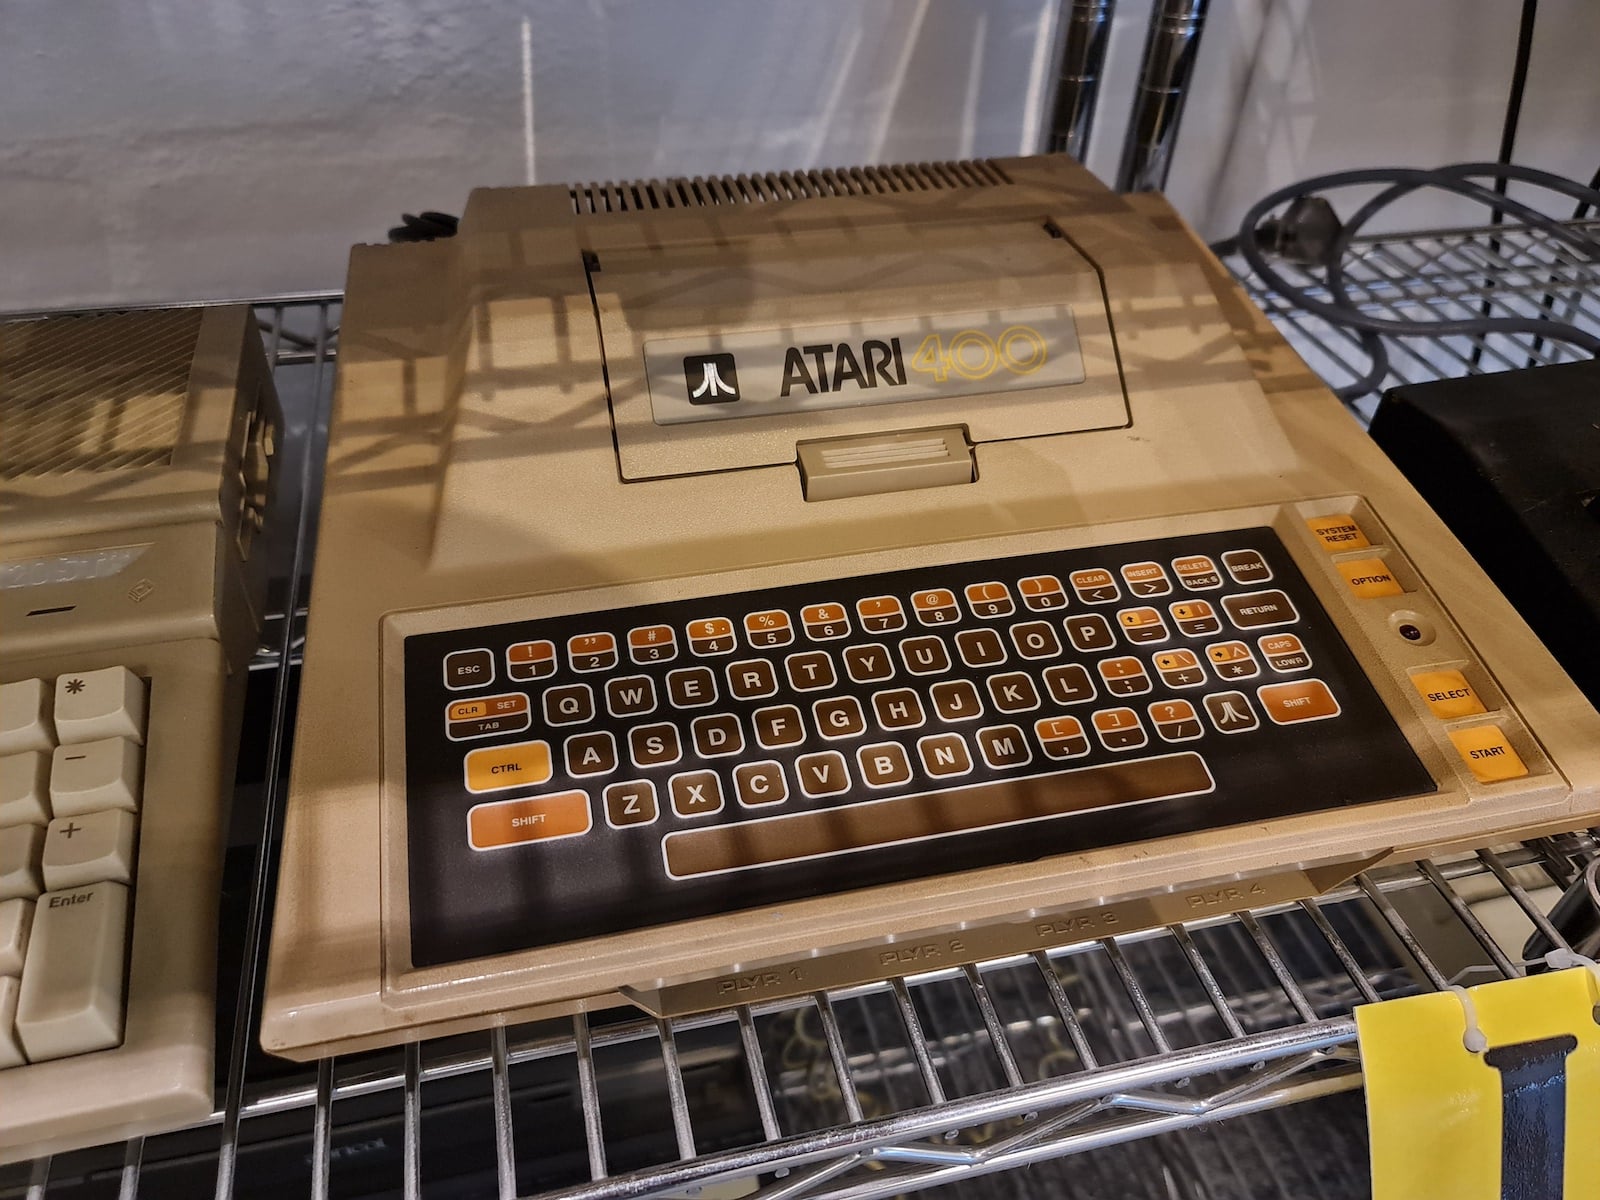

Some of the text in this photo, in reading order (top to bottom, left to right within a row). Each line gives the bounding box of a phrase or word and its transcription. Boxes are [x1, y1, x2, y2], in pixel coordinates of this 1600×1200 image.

[780, 325, 1047, 397] ATARI 400
[1316, 525, 1357, 536] SYSTEM
[1325, 532, 1358, 543] RESET
[1127, 568, 1158, 579] INSERT
[1176, 561, 1209, 572] DELETE
[1231, 561, 1264, 573] BREAK
[1076, 574, 1106, 584] CLEAR
[1186, 578, 1209, 587] BACK
[1351, 574, 1391, 586] OPTION
[926, 594, 939, 605] @
[818, 609, 829, 619] &
[988, 604, 999, 614] 9
[1239, 604, 1278, 617] RETURN
[759, 615, 775, 627] %
[878, 618, 889, 628] 7
[934, 611, 945, 622] 8
[648, 630, 656, 641] #
[704, 622, 714, 635] $
[824, 625, 834, 636] 6
[1079, 626, 1096, 642] P
[709, 640, 718, 651] 4
[767, 633, 777, 644] 5
[1026, 633, 1045, 649] O
[1267, 640, 1292, 650] CAPS
[650, 649, 659, 659] 3
[976, 641, 986, 657] I
[590, 657, 600, 667] 2
[915, 648, 934, 665] U
[1275, 657, 1304, 667] LOWR
[457, 665, 480, 675] ESC
[529, 665, 536, 675] 1
[859, 656, 875, 672] Y
[801, 663, 818, 680] T
[742, 671, 762, 689] R
[1060, 677, 1079, 694] L
[684, 679, 701, 698] E
[1002, 684, 1024, 702] K
[1428, 688, 1471, 702] SELECT
[619, 687, 643, 706] W
[950, 693, 963, 711] J
[1283, 696, 1311, 709] SHIFT
[458, 700, 517, 715] CLR SET
[559, 697, 579, 714] Q
[888, 701, 909, 720] H
[1164, 706, 1175, 717] ?
[478, 721, 499, 730] TAB
[829, 710, 850, 728] G
[770, 718, 786, 737] F
[707, 728, 727, 747] D
[646, 736, 664, 755] S
[991, 737, 1016, 757] M
[582, 747, 601, 765] A
[934, 746, 955, 766] N
[1470, 746, 1506, 760] START
[491, 764, 522, 774] CTRL
[873, 756, 894, 775] B
[812, 765, 829, 784] V
[750, 775, 769, 794] C
[686, 784, 707, 805] X
[622, 795, 640, 815] Z
[512, 814, 547, 827] SHIFT
[49, 891, 94, 908] Enter
[1186, 882, 1266, 908] PLYR 4
[1035, 912, 1119, 937] PLYR 3
[880, 940, 966, 965] PLYR 2
[718, 967, 803, 995] PLYR 1
